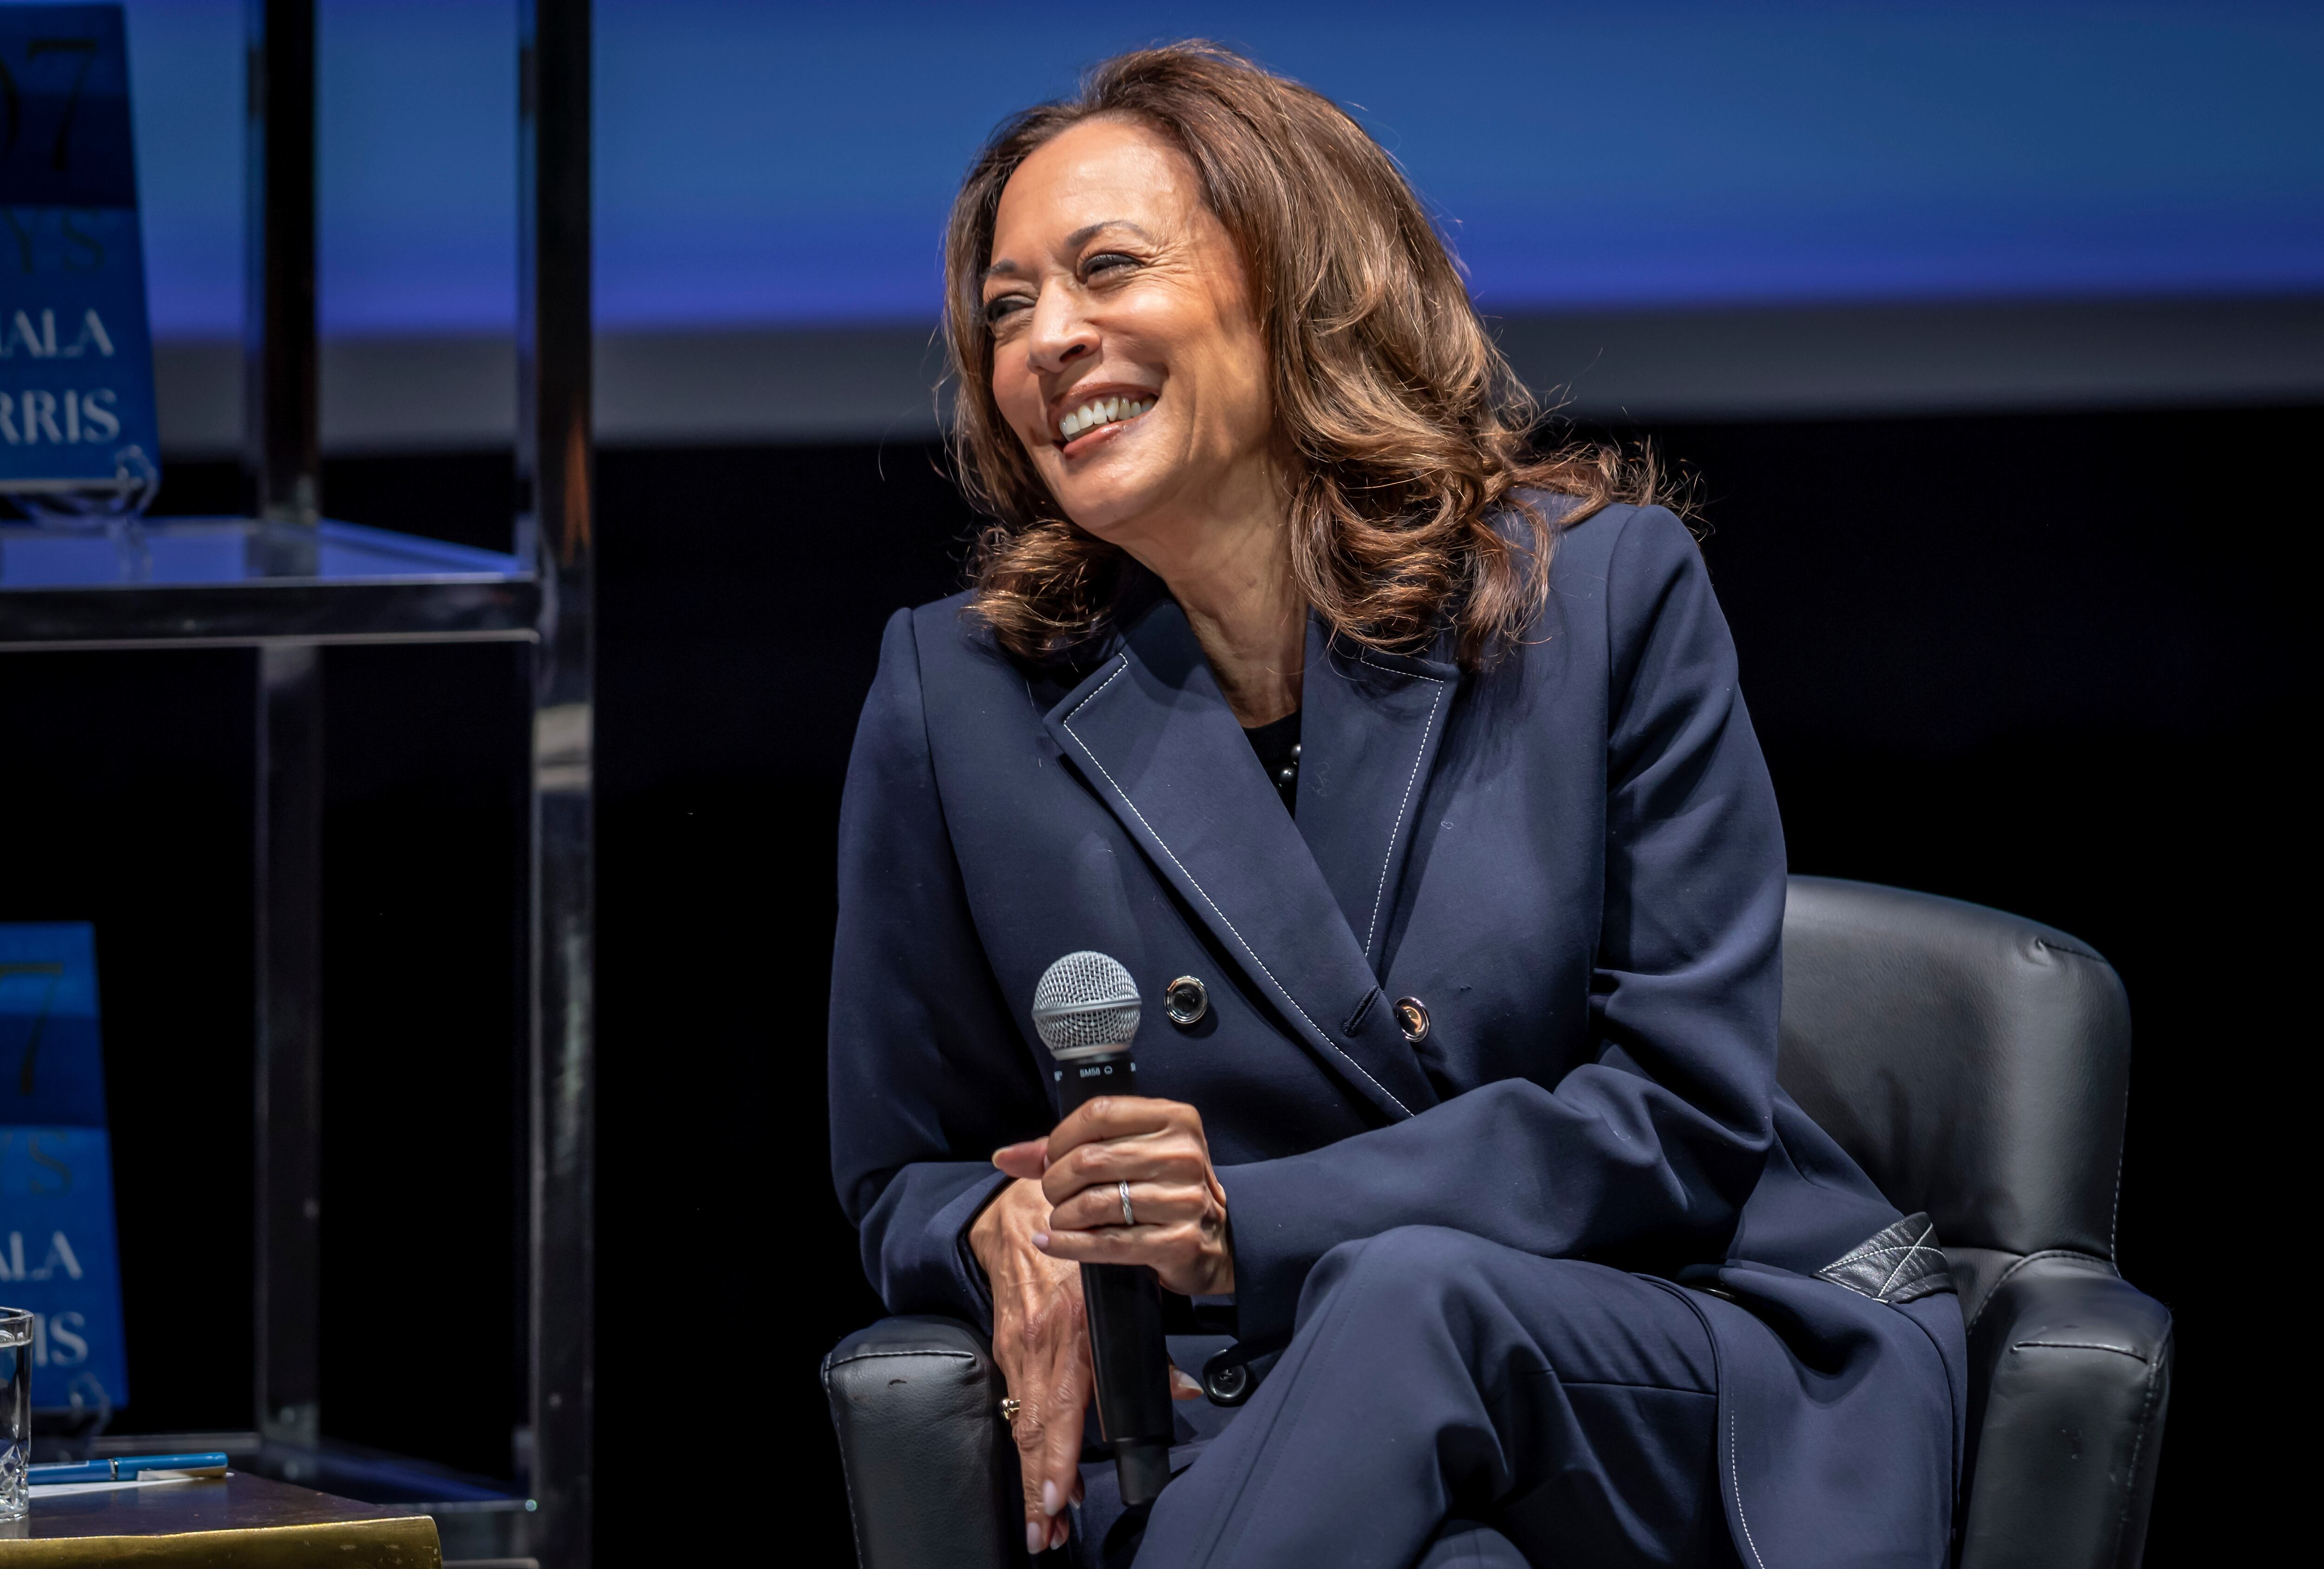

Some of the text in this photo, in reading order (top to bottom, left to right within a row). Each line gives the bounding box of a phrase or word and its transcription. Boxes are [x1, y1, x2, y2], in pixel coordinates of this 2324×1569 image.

[0, 37, 95, 171] 7
[0, 307, 115, 358] ALA
[0, 1231, 83, 1282] LA
